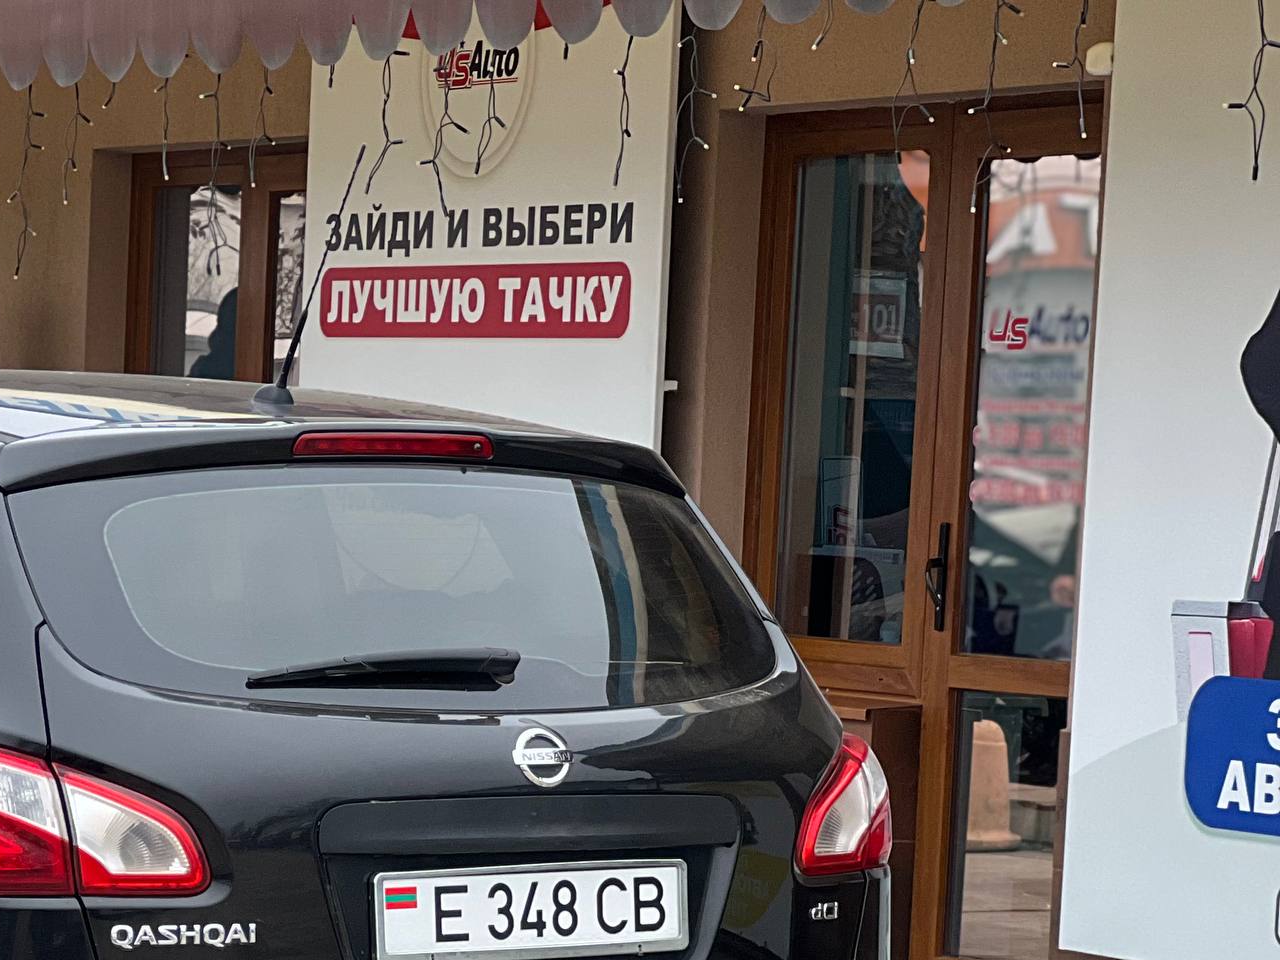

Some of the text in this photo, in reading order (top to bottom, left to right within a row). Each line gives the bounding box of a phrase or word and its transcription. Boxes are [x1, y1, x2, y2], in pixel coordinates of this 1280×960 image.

[324, 201, 634, 258] ЗАЙДИ И ВЫБЕРИ
[326, 275, 623, 324] ЛУЧШУЮ ТАЧКУ
[521, 751, 571, 762] NISSAN
[487, 879, 578, 940] 348
[596, 876, 666, 934] CB
[110, 923, 257, 949] QASHQAI
